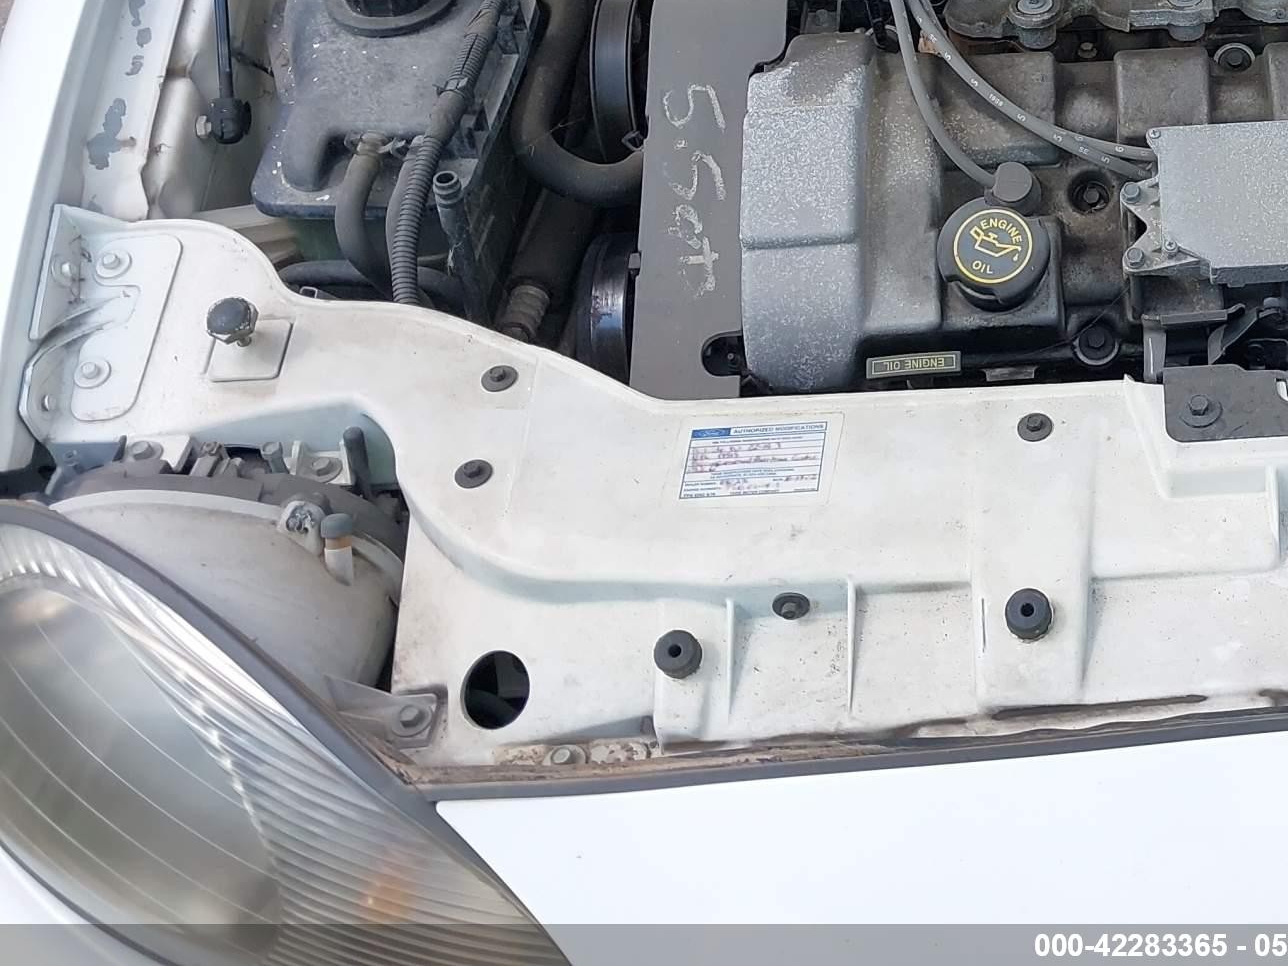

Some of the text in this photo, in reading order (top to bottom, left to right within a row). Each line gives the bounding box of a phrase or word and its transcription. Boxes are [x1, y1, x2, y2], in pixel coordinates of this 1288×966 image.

[980, 218, 1022, 244] ENGINE
[972, 260, 993, 274] OIL
[883, 357, 945, 371] ENGINE OIL
[734, 426, 774, 434] AUTHORIZED
[774, 424, 825, 432] MODIFICATIONS
